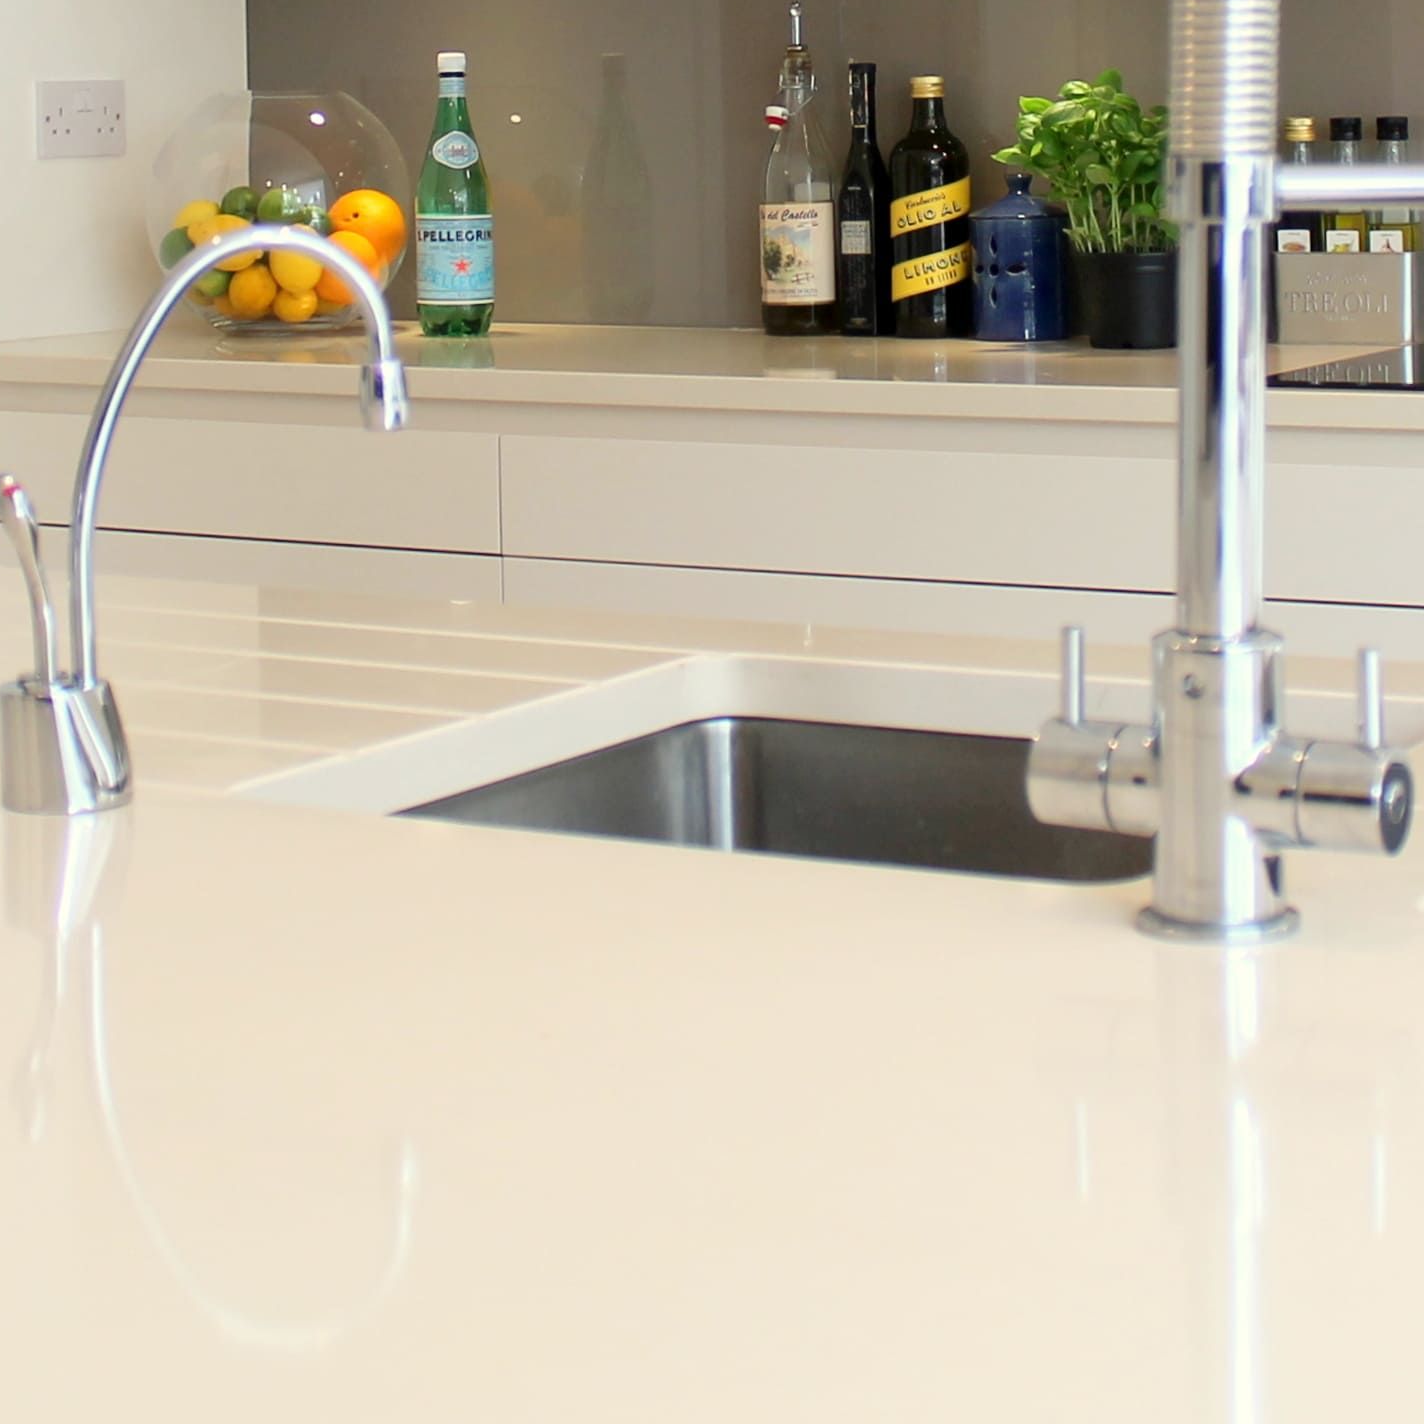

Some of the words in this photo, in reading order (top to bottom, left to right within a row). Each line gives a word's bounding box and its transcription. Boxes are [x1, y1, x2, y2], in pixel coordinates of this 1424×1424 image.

[781, 208, 818, 222] Castello
[897, 209, 937, 229] OLIO
[941, 200, 962, 217] AL
[1284, 291, 1338, 313] TRE
[1343, 291, 1390, 313] OLI
